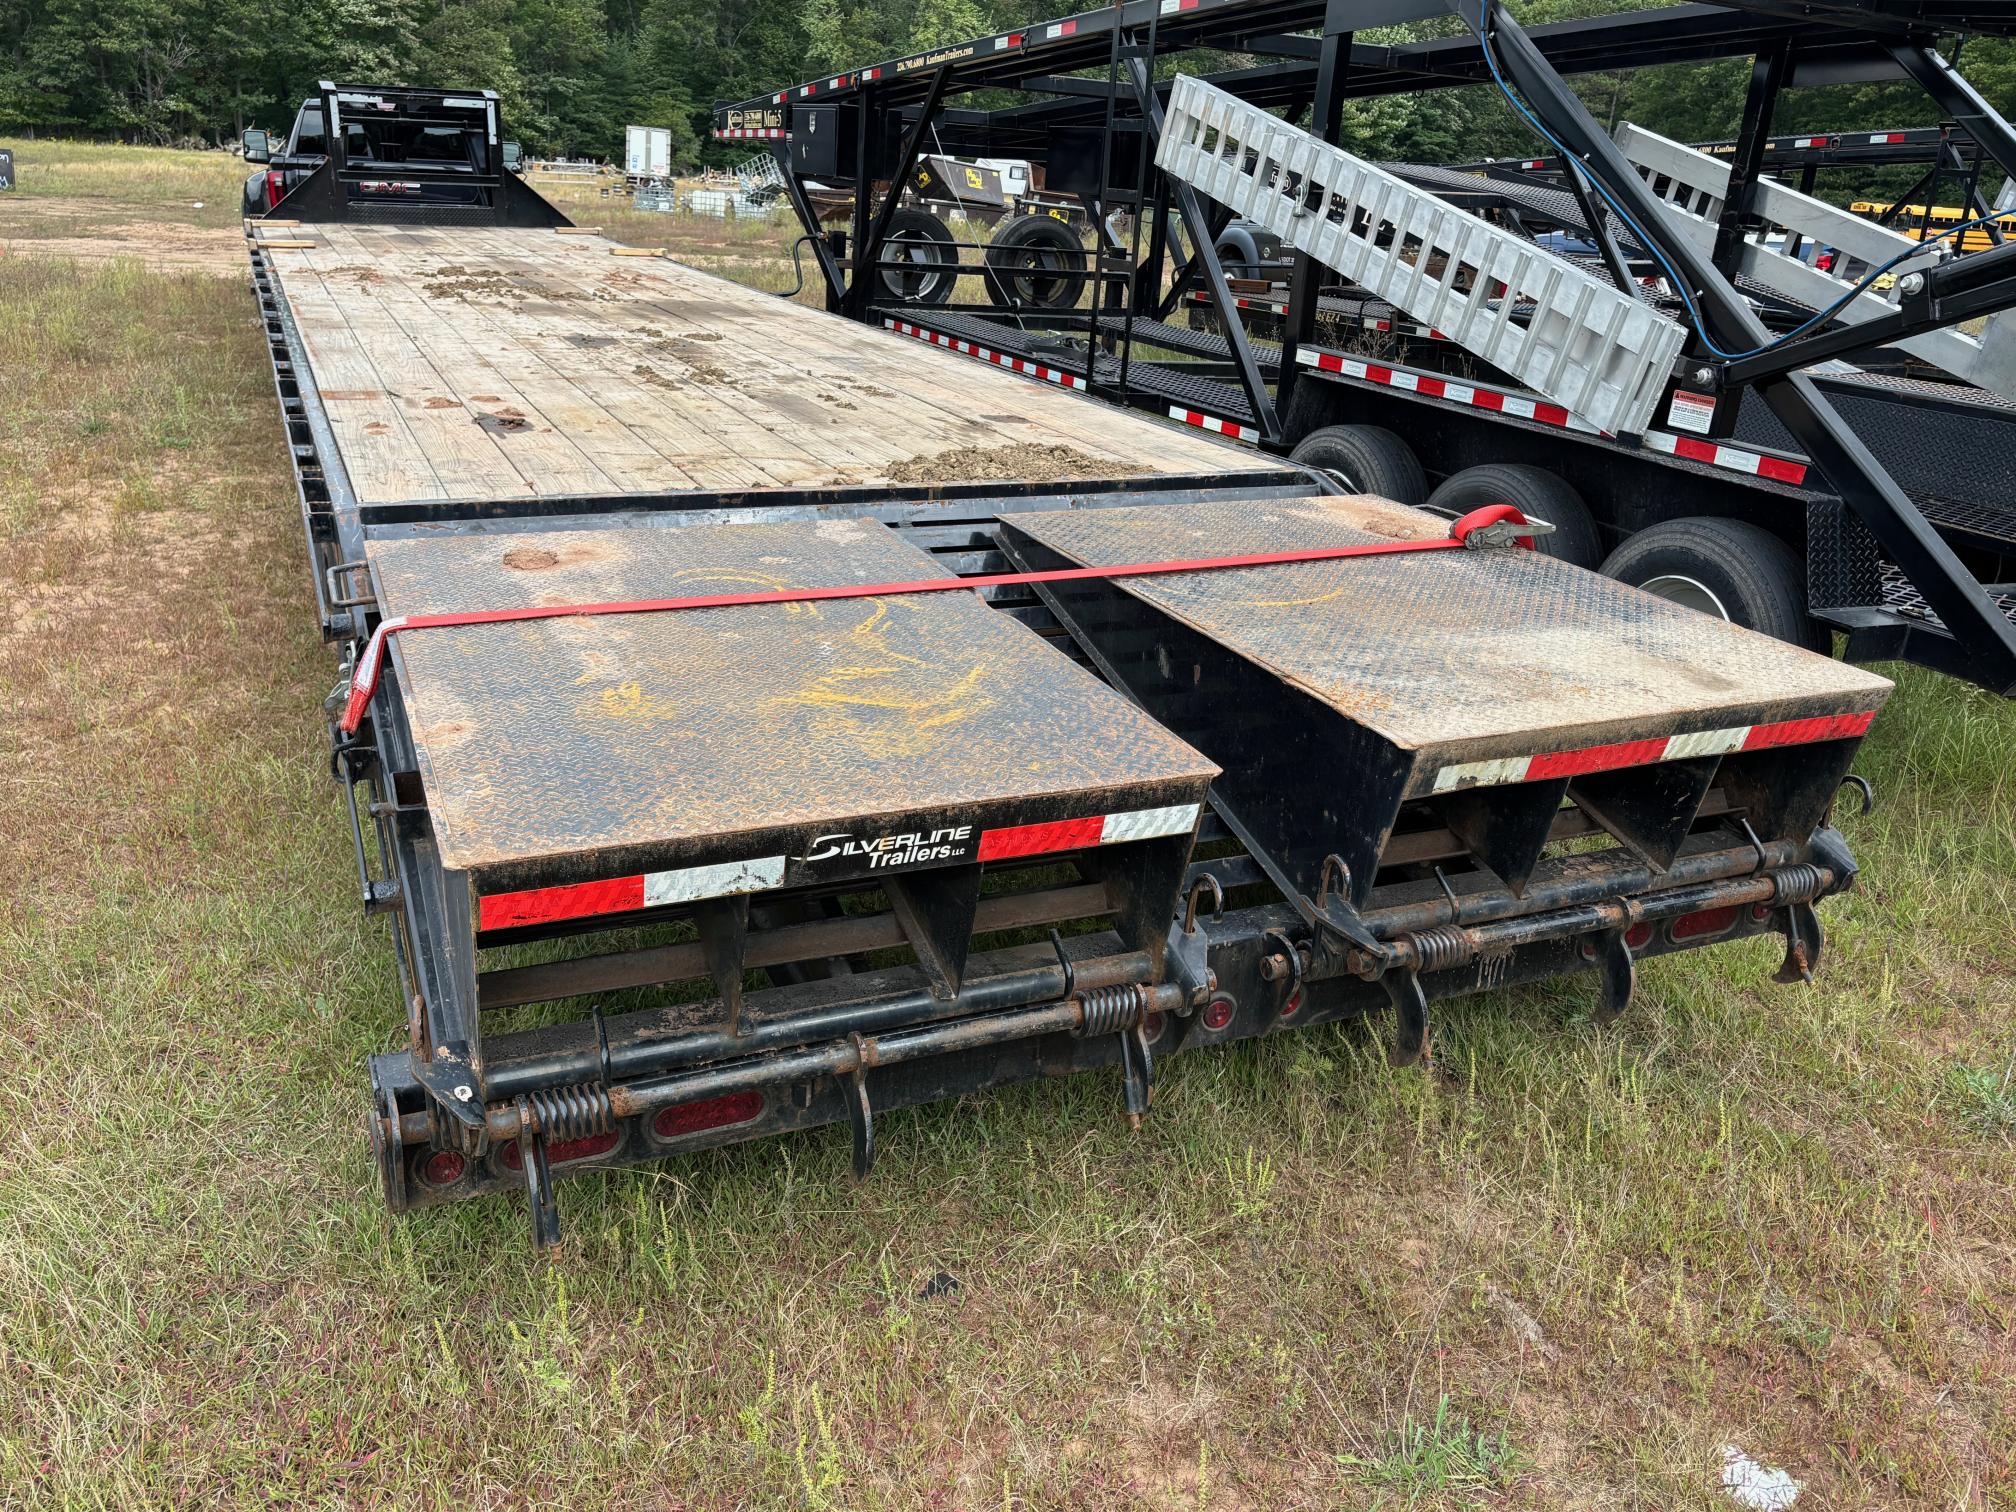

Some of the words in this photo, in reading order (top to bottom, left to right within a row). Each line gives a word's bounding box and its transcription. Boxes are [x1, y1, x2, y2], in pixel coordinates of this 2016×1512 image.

[1713, 144, 1737, 154] Kaufma
[360, 181, 421, 193] GMC
[869, 845, 951, 869] Trailers
[951, 847, 966, 856] LLC
